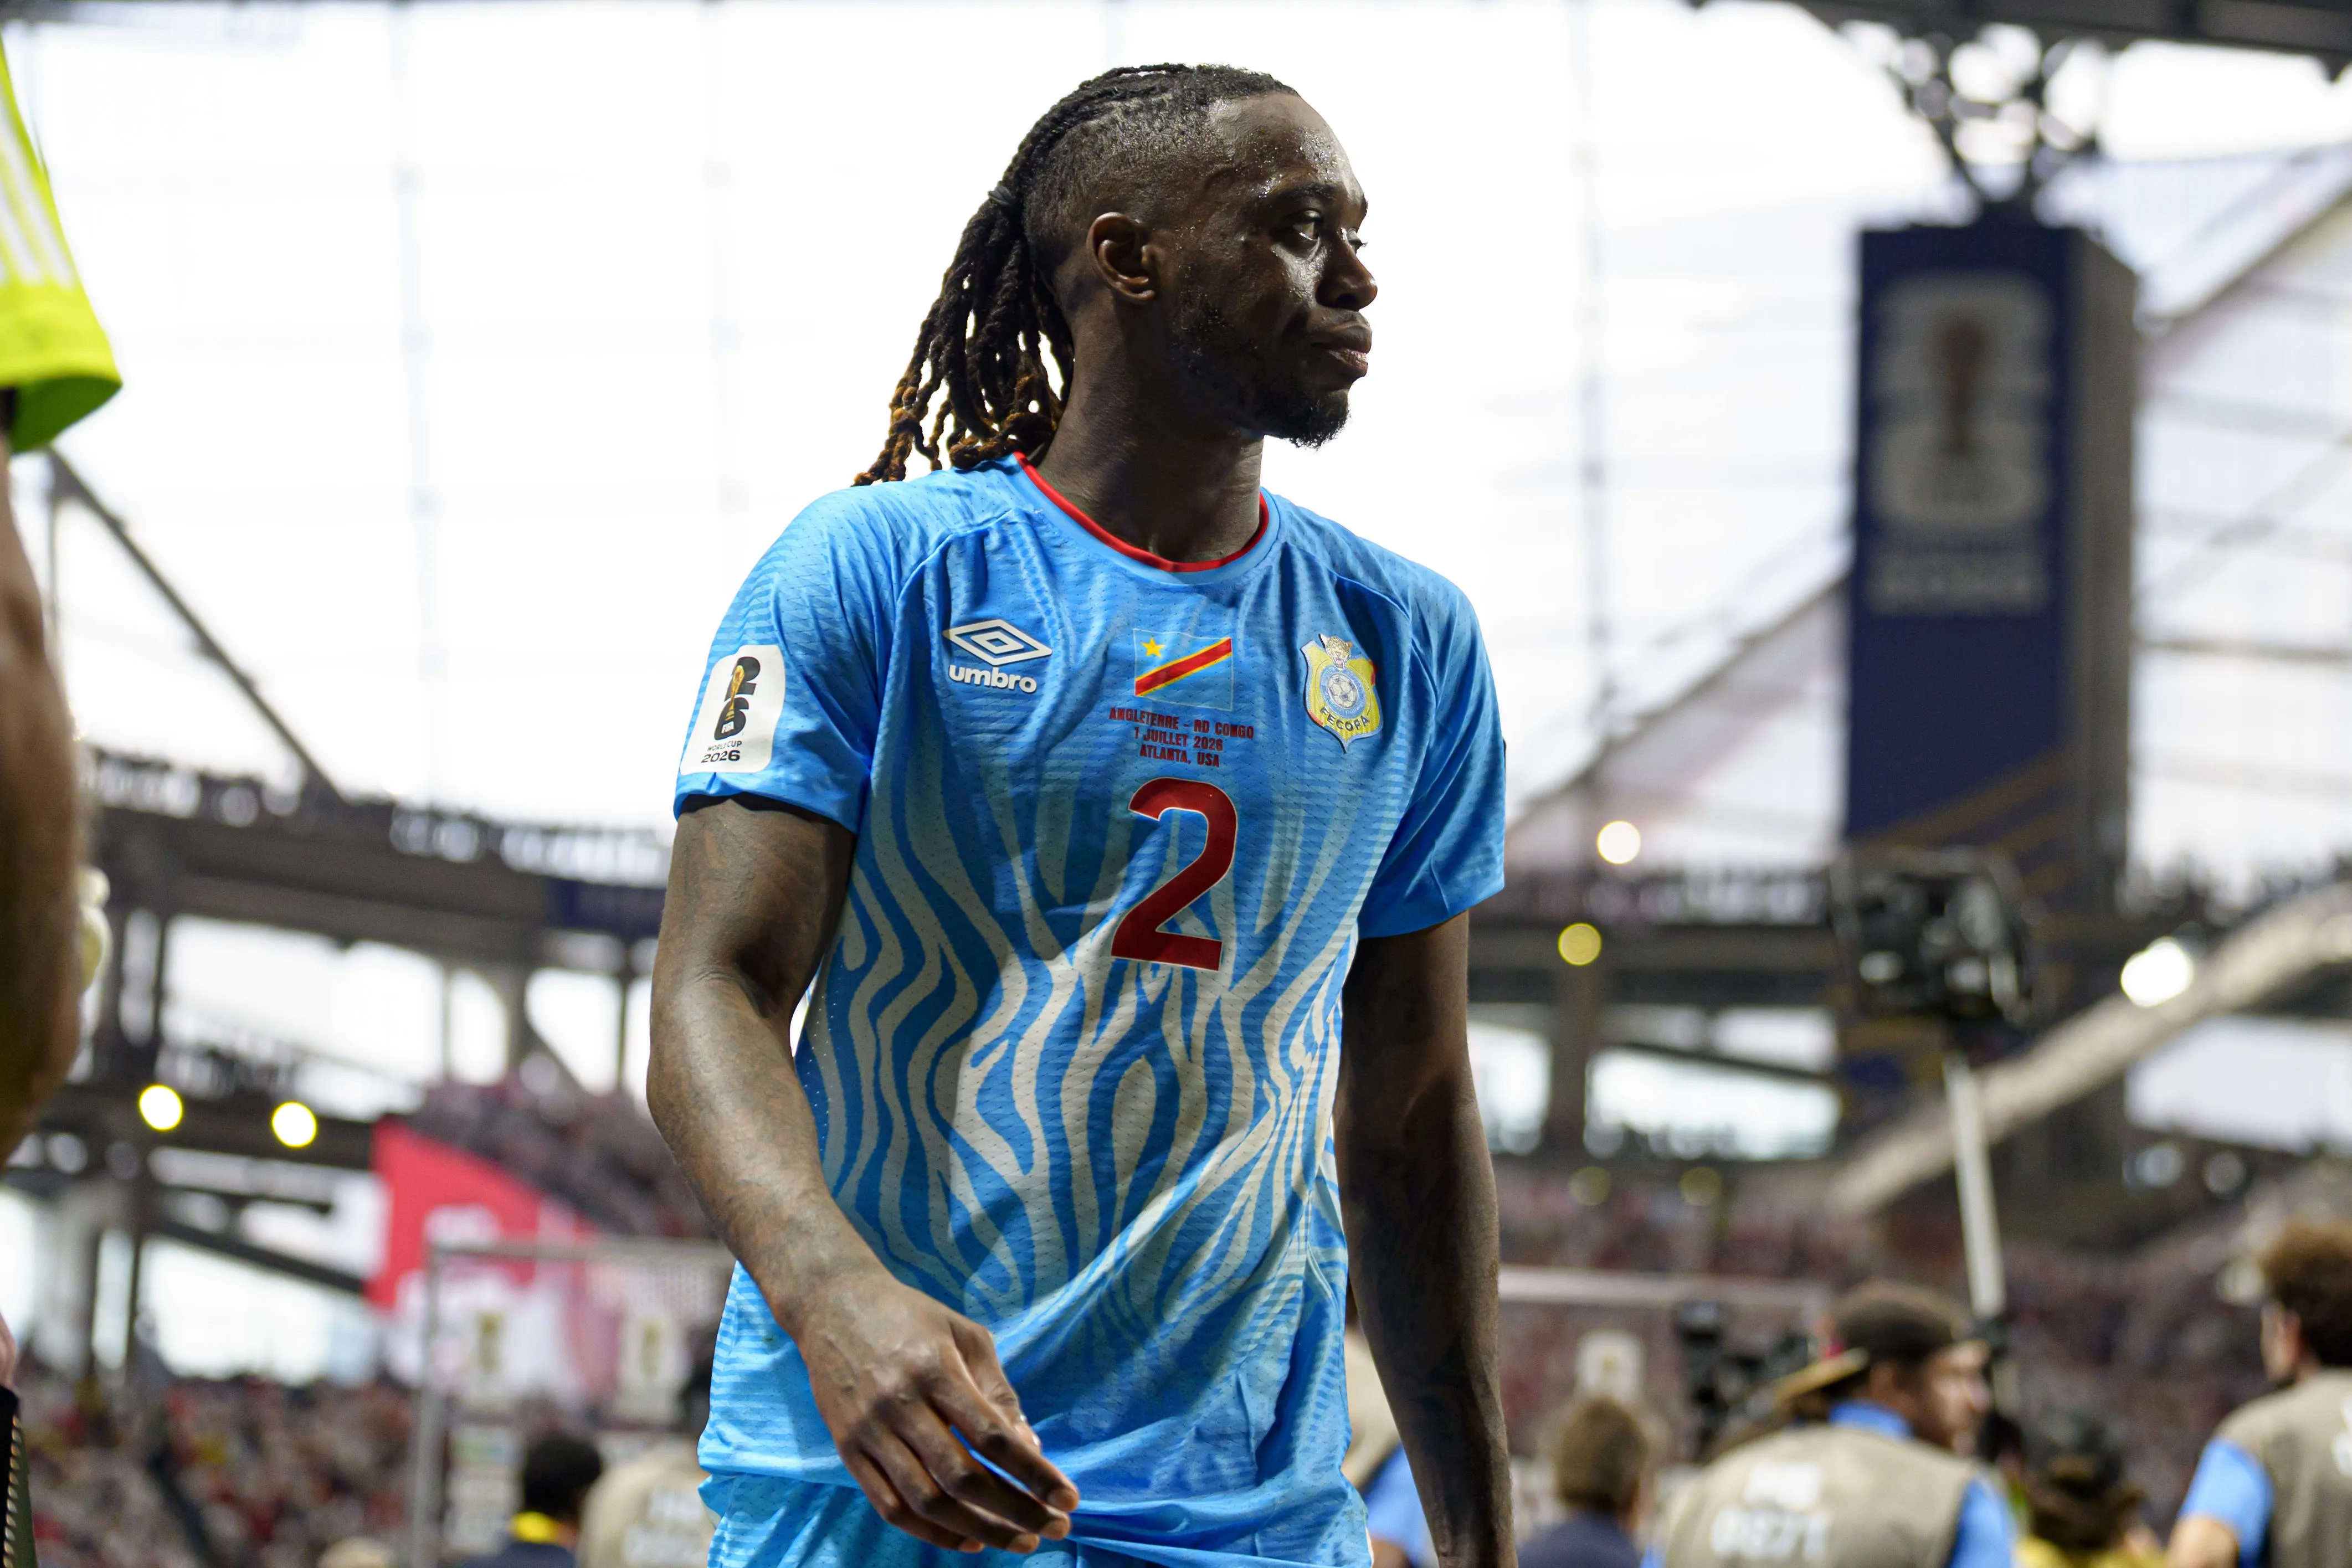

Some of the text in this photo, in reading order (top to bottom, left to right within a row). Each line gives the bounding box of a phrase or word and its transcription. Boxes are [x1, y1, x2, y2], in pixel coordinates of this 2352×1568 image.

[949, 665, 1037, 693] umbro
[1109, 707, 1179, 730] ANGLETERRE
[1194, 719, 1210, 734] RD
[1215, 722, 1254, 739] CONGO
[1320, 706, 1370, 732] FECOFA
[1134, 727, 1223, 752] 1 JUILLET 2026
[701, 749, 741, 763] 2026
[1139, 744, 1220, 768] ATLANTA, USA
[1111, 777, 1238, 971] 2
